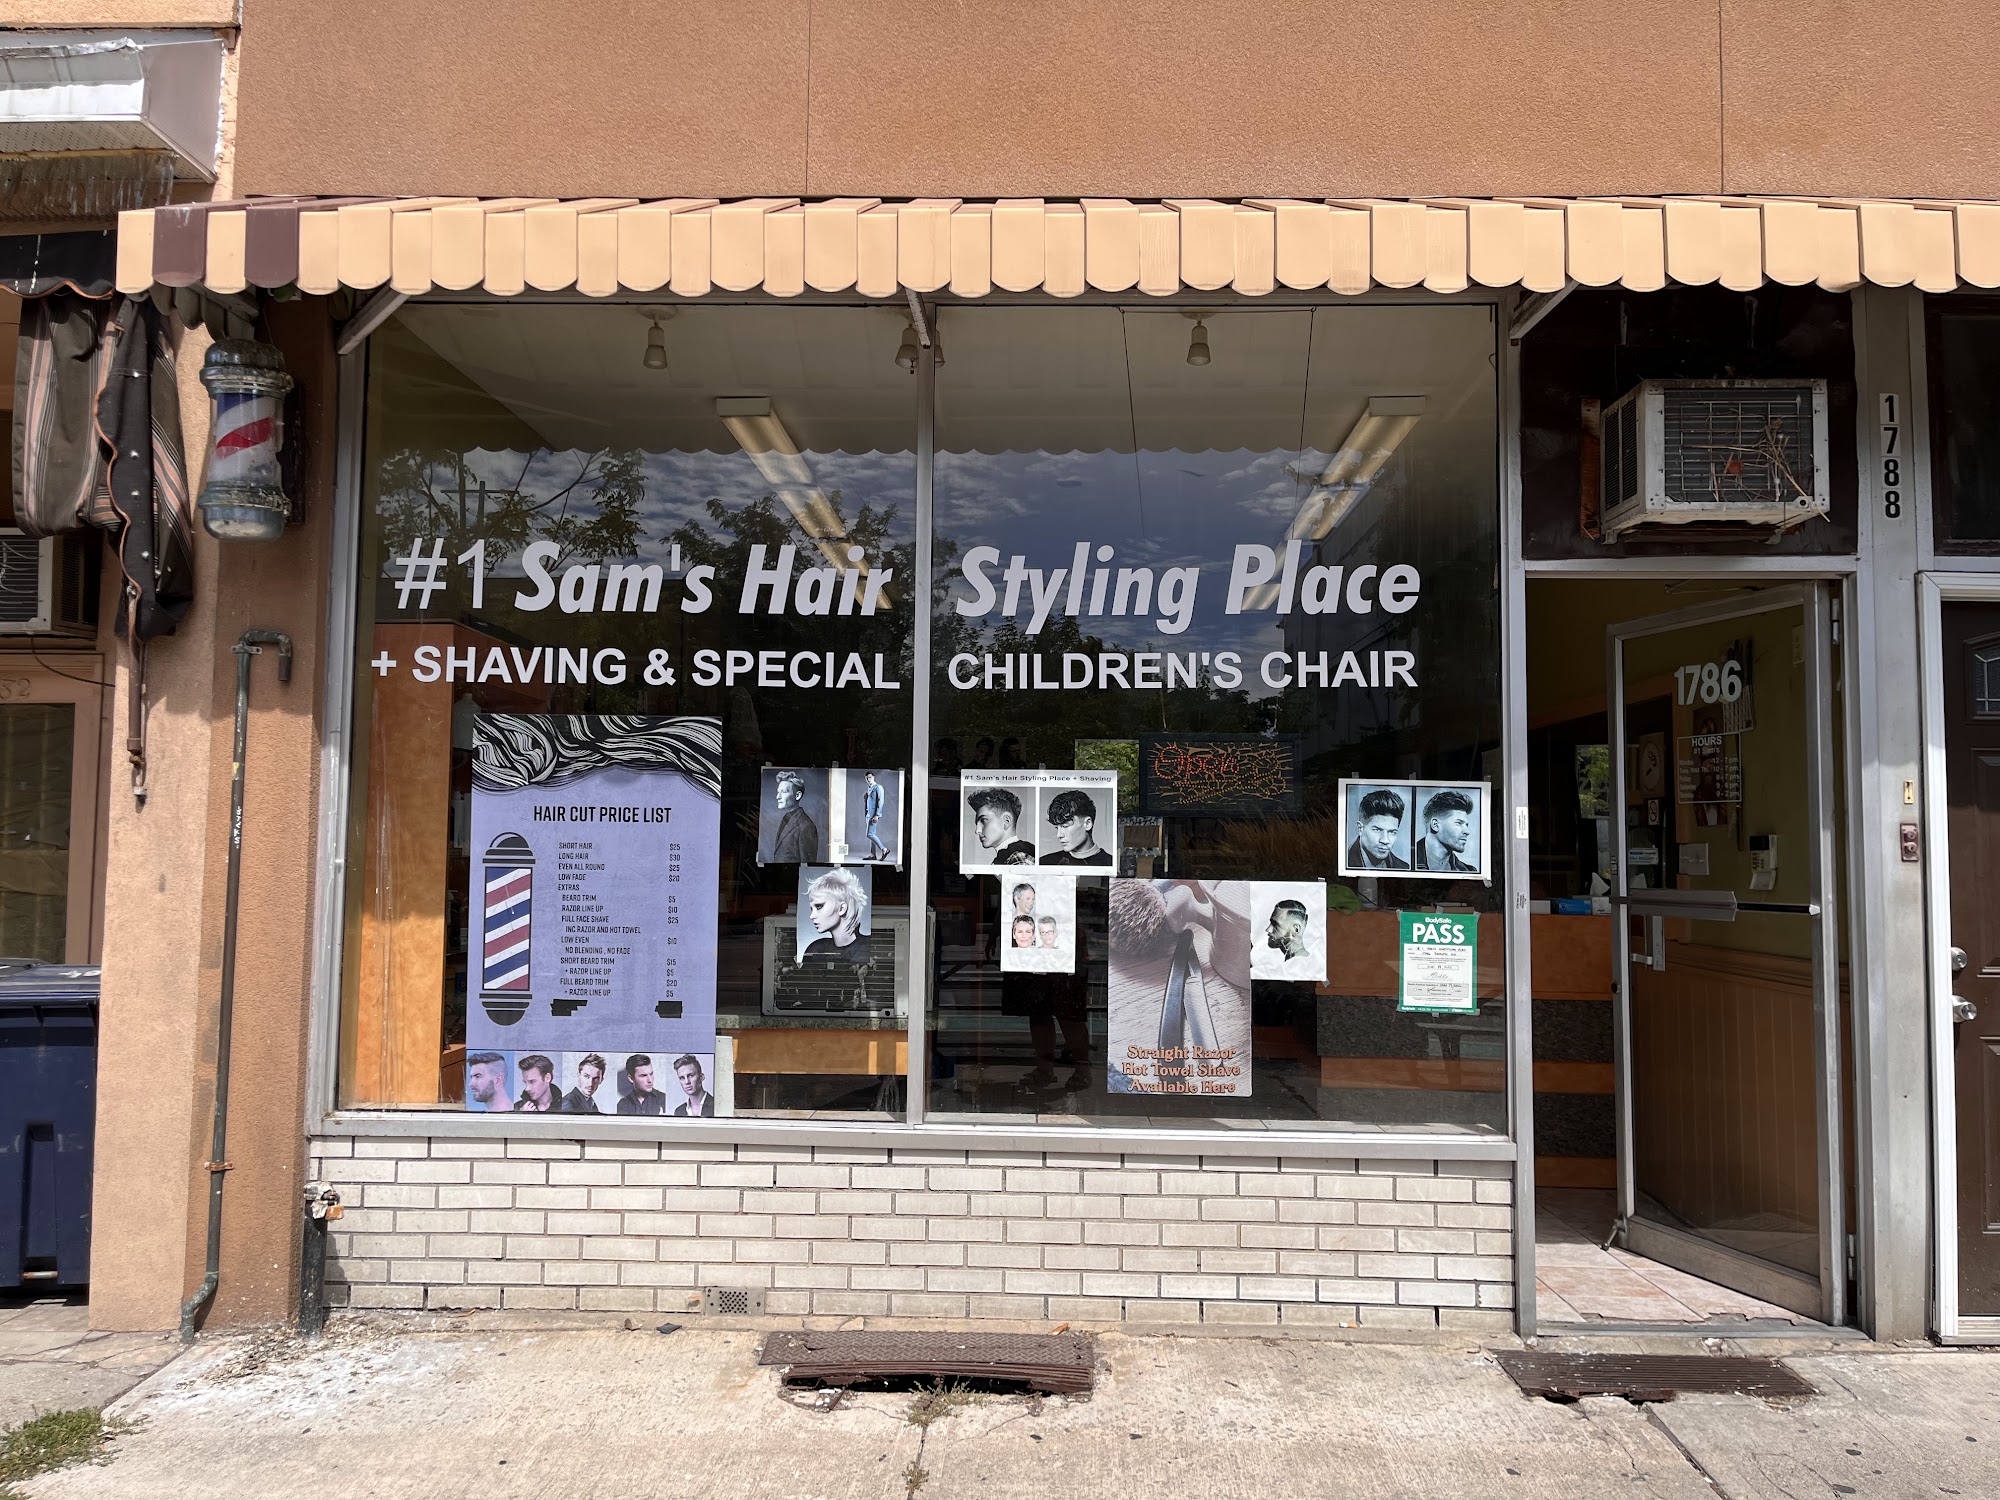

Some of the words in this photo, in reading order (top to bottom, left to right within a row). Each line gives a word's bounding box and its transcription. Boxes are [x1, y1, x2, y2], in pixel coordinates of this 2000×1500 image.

[1884, 395, 1900, 518] 1788
[395, 537, 484, 610] #1
[514, 541, 715, 614] Sam's
[738, 544, 894, 616] Hair
[956, 541, 1199, 635] Styling
[1225, 539, 1421, 615] Place
[412, 645, 627, 685] SHAVING
[644, 648, 676, 686] &
[691, 649, 900, 690] SPECIAL
[948, 651, 1243, 690] CHILDREN'S
[1260, 650, 1419, 688] CHAIR
[1674, 660, 1742, 706] 1786
[1692, 736, 1722, 747] HOURS
[1154, 745, 1240, 782] Open
[534, 806, 566, 822] HAIR
[570, 806, 596, 822] CUT
[599, 807, 639, 823] PRICE
[643, 808, 672, 823] LIST
[1413, 923, 1465, 944] PASS
[1127, 1045, 1189, 1062] Straight
[1192, 1045, 1237, 1060] Razor
[1122, 1062, 1148, 1076] Hot
[1151, 1063, 1194, 1077] Towel
[1197, 1063, 1241, 1077] Shave
[1128, 1079, 1198, 1094] Available
[1201, 1080, 1236, 1094] Here
